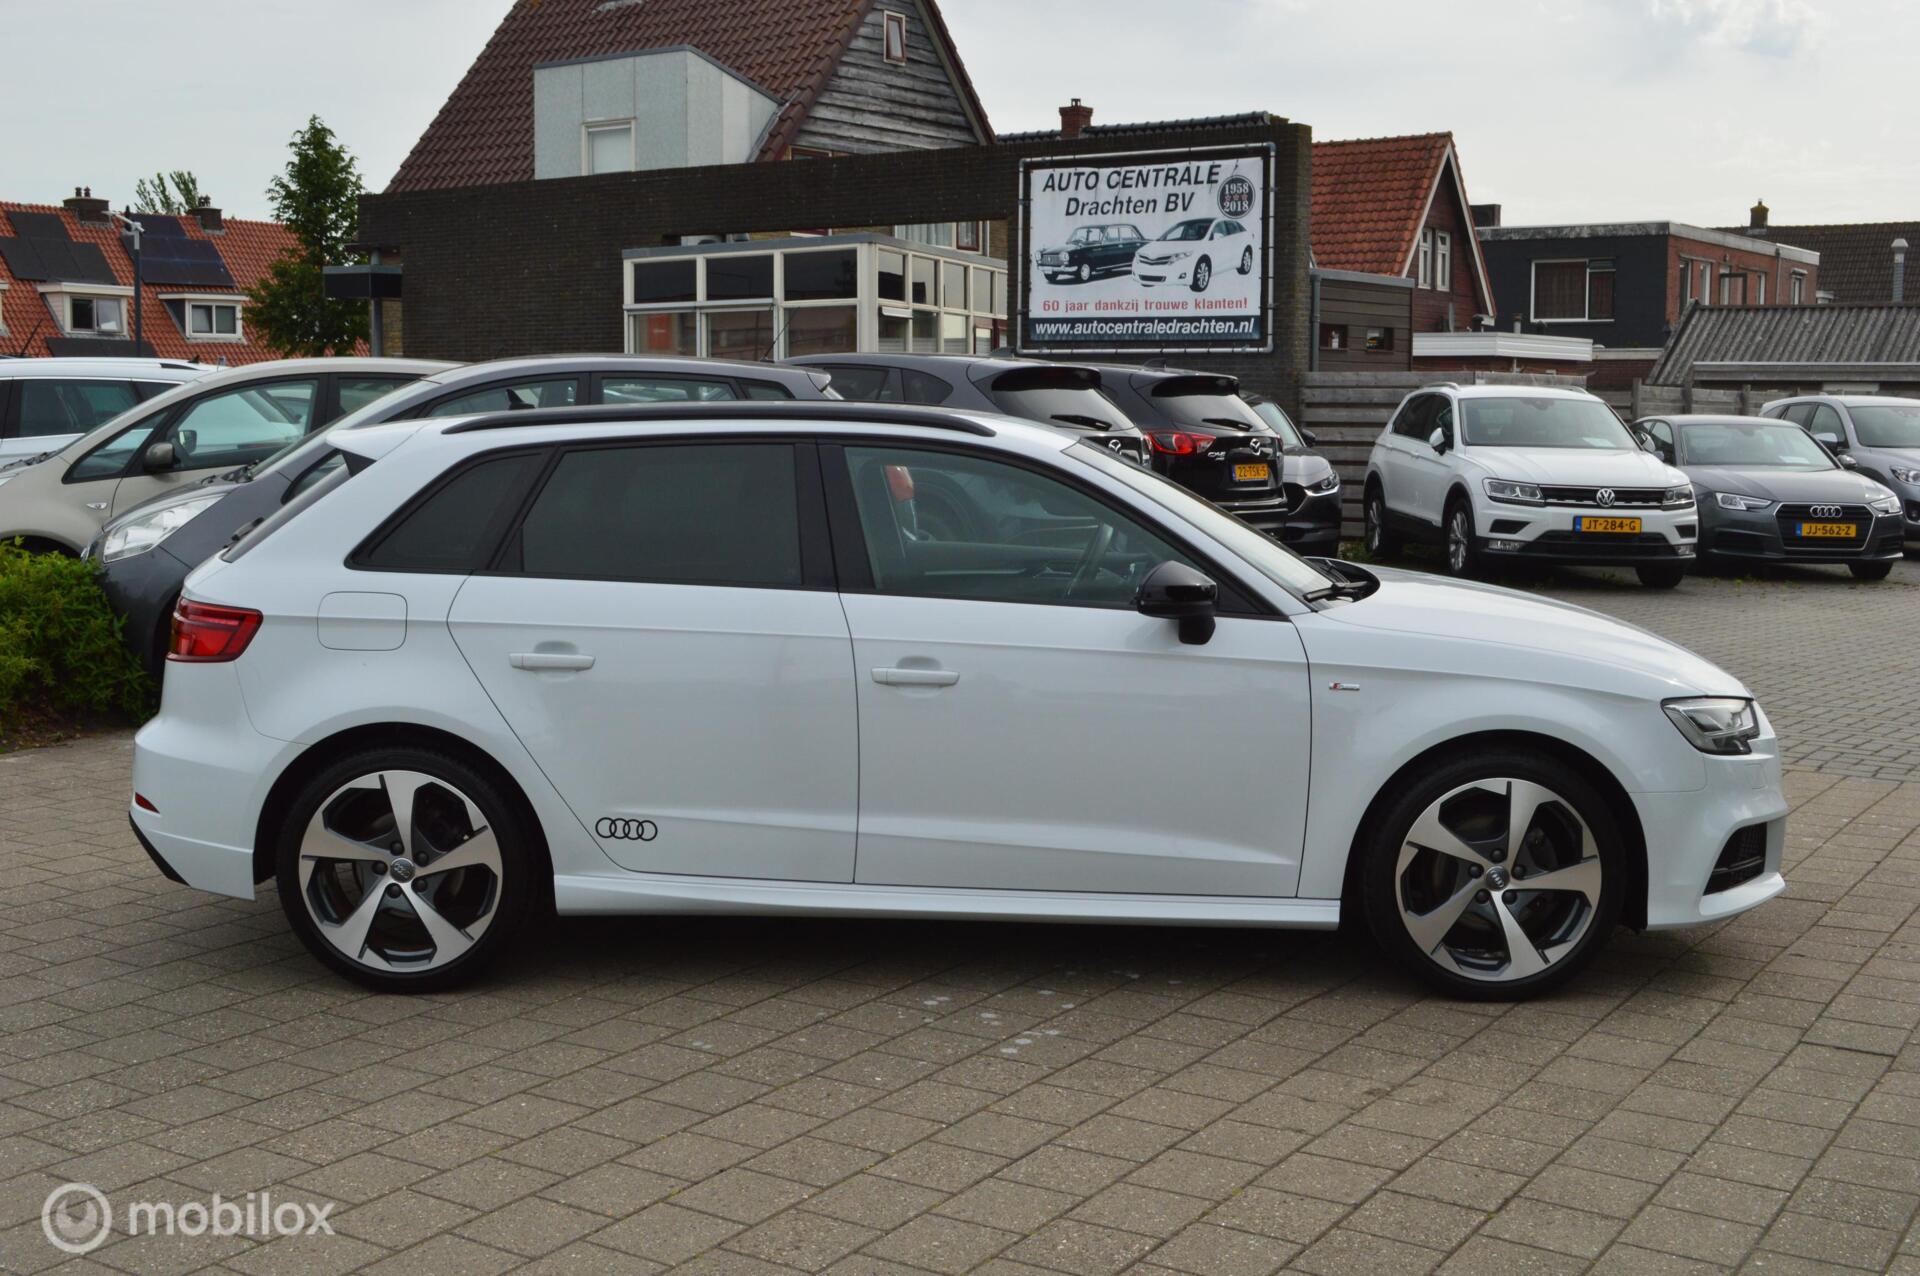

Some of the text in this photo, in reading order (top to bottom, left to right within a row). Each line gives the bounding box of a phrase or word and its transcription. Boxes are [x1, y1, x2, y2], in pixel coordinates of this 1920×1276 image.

[1042, 164, 1222, 193] AUTO CENTRALE
[1224, 182, 1250, 195] 1958
[1065, 192, 1196, 217] Drachten BV
[1223, 199, 1250, 213] 2018
[1042, 297, 1249, 313] 60 jaar dankzij trouwe klanten!
[1035, 317, 1255, 336] www.autocentraledrachten.nl
